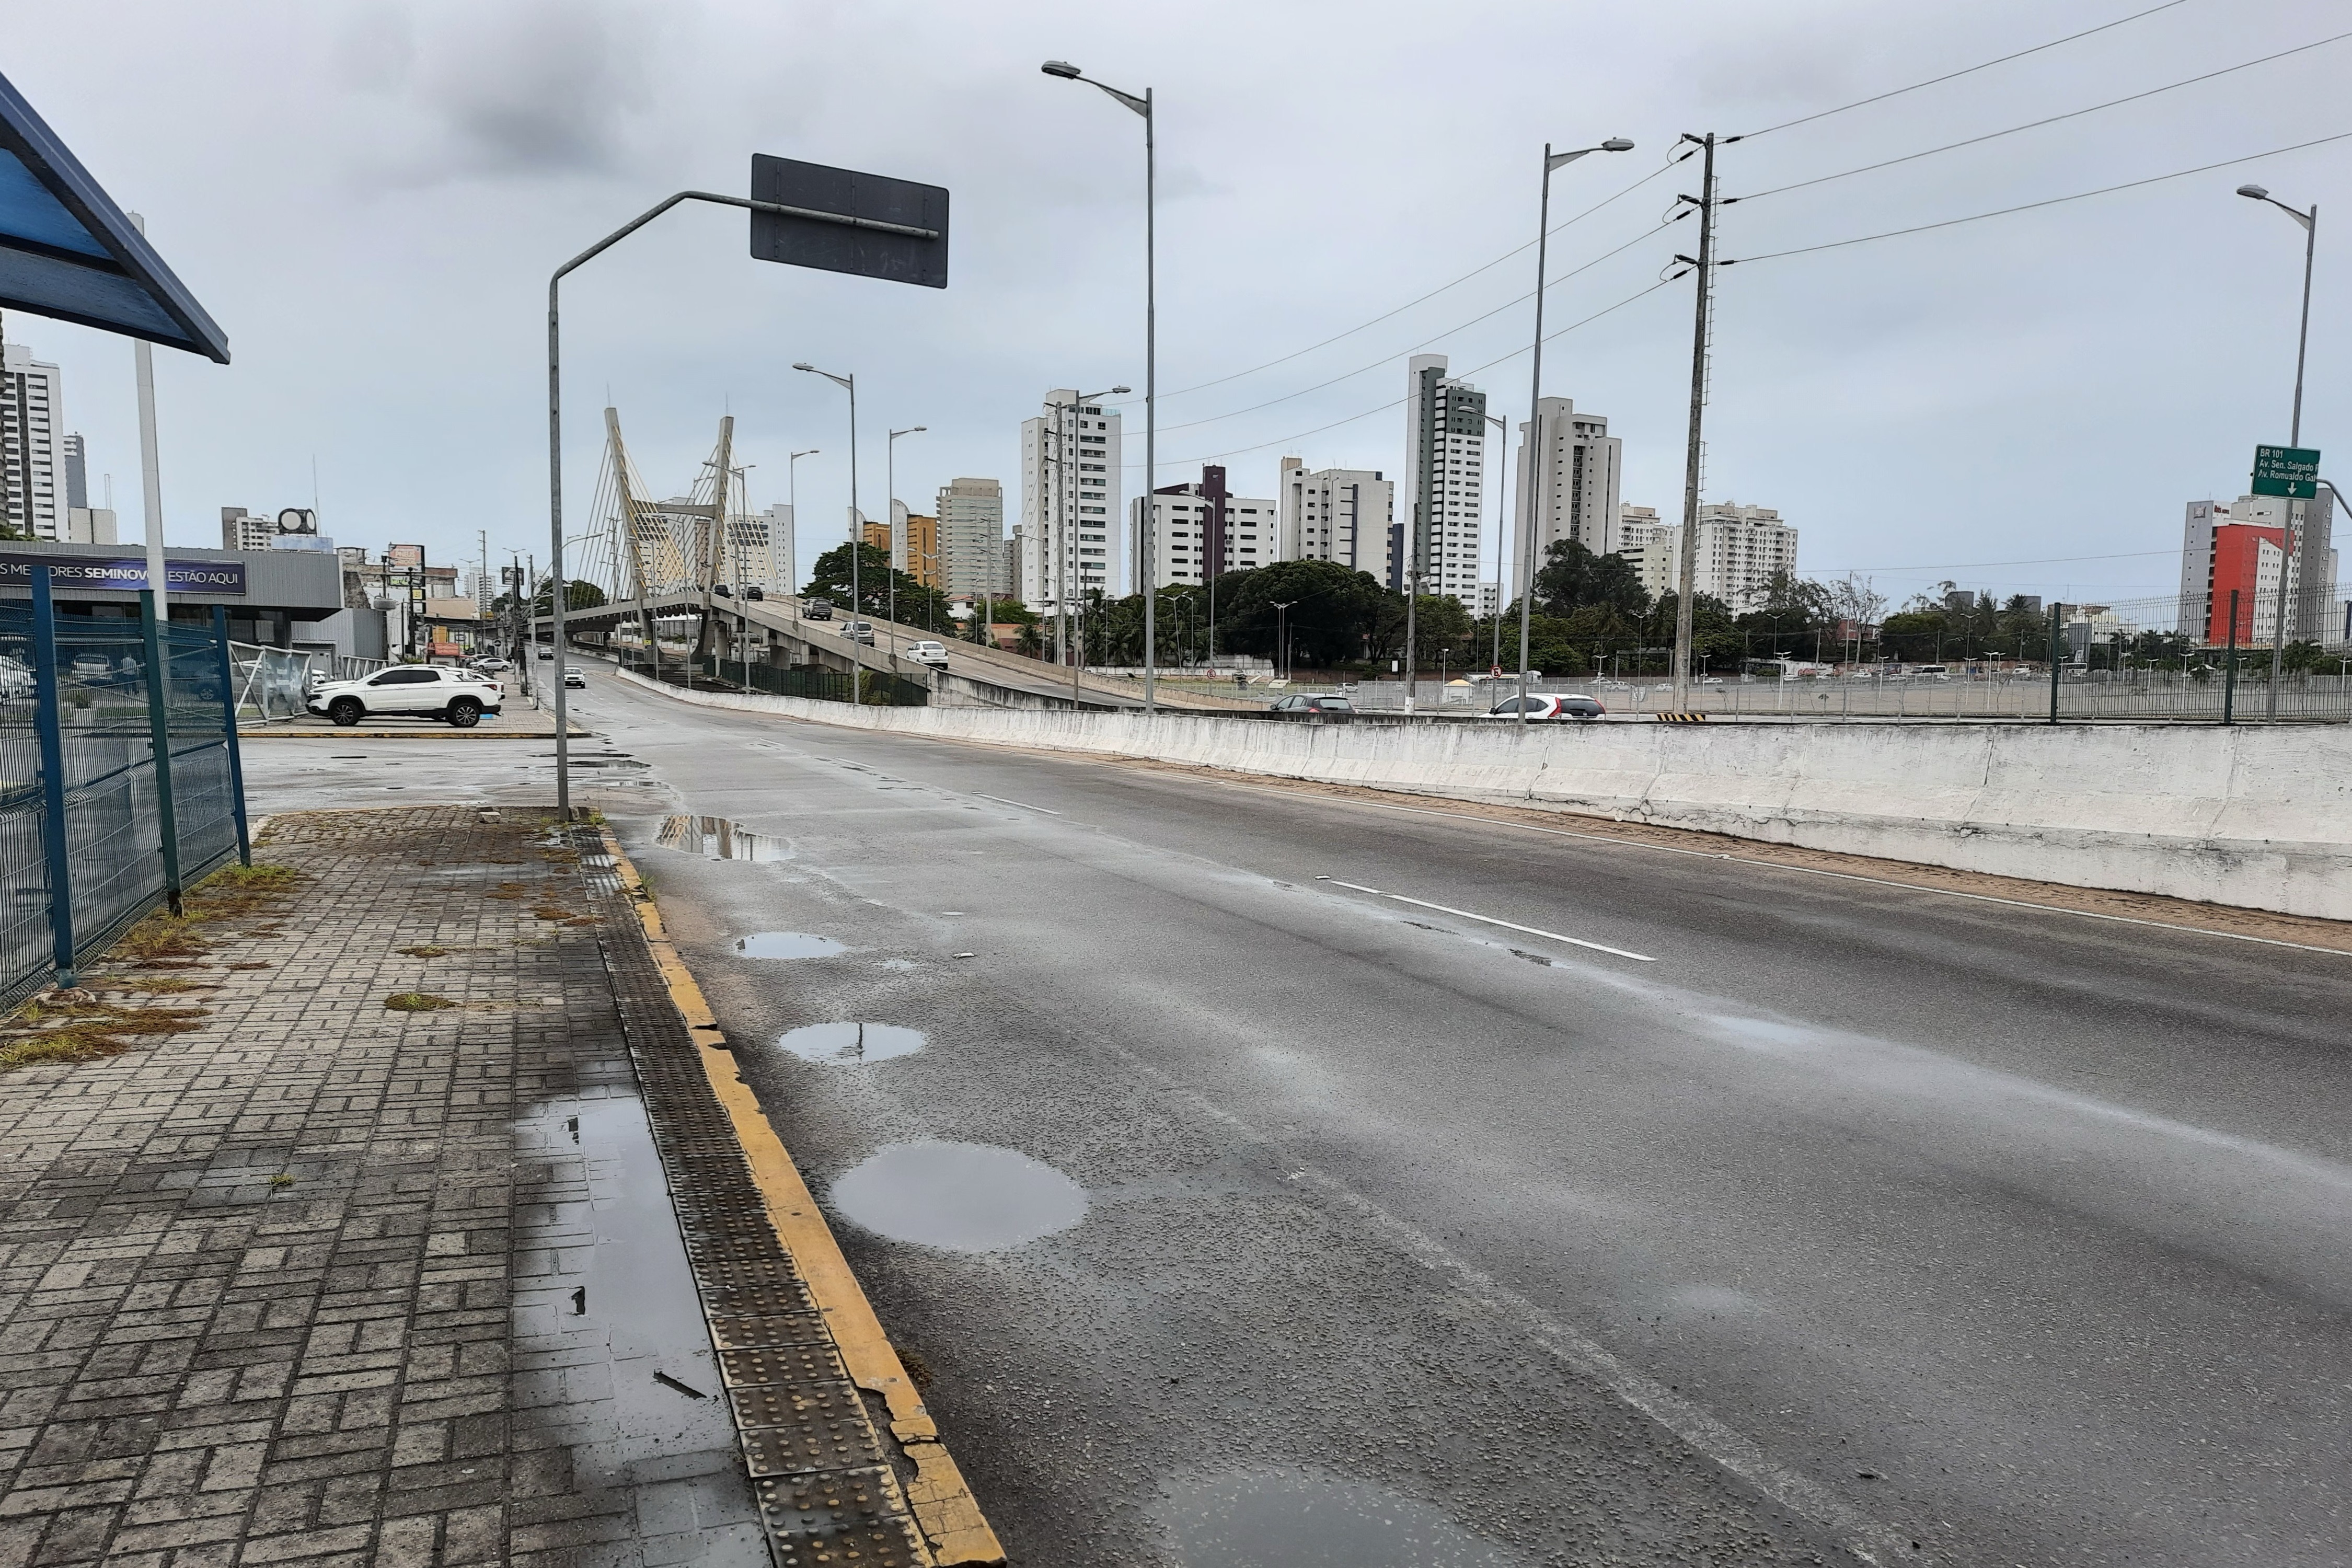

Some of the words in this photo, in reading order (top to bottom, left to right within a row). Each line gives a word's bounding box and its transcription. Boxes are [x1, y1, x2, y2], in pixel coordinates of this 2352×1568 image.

[2260, 448, 2270, 457] BR
[2272, 450, 2284, 458] 101
[2259, 459, 2269, 468] Av.
[2271, 460, 2285, 469] Sen.
[2287, 461, 2314, 472] Salgado
[2258, 469, 2268, 478] Av.
[2270, 470, 2303, 480] Romualdo
[2305, 473, 2316, 482] Gal
[10, 564, 83, 578] MEORES
[85, 568, 149, 581] SEMINOV
[168, 570, 206, 583] ESTÃO
[208, 573, 238, 585] AQUI
